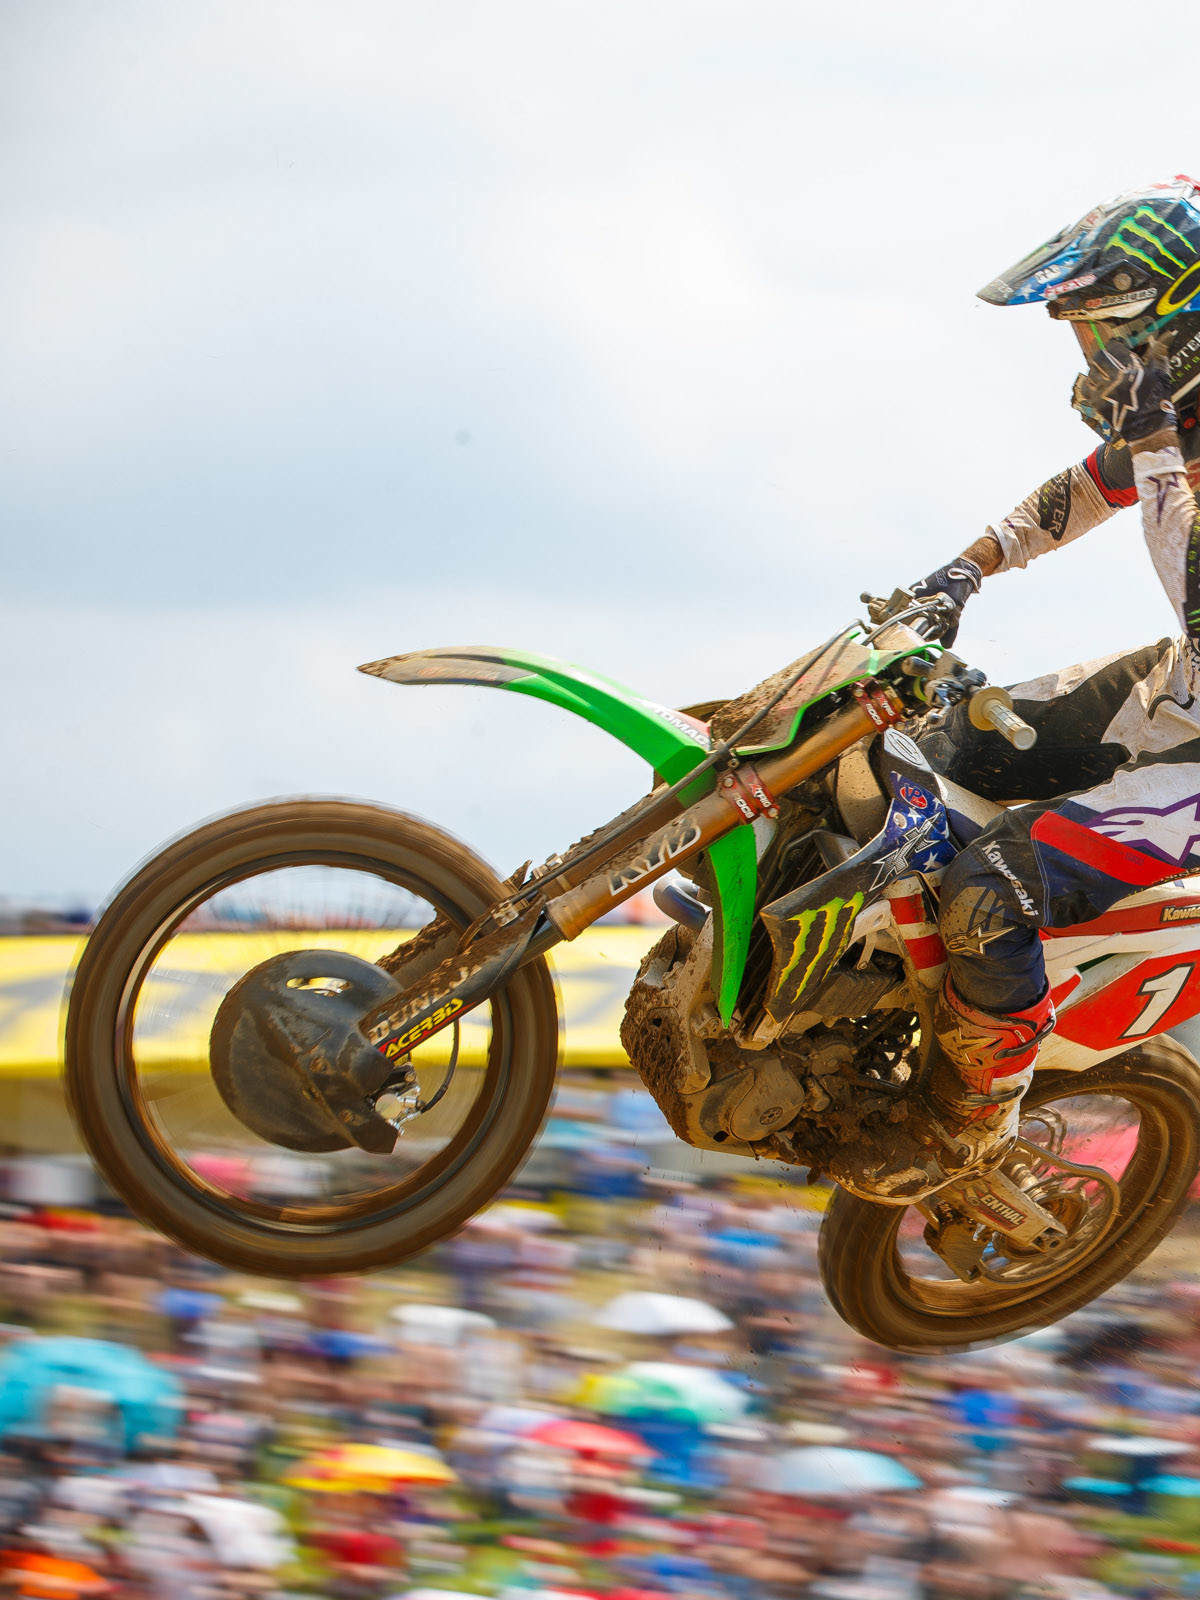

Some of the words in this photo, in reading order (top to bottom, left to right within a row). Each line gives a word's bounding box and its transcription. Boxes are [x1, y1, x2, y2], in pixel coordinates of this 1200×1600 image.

[654, 708, 710, 746] TOMAC
[981, 840, 1039, 917] Kawasaki
[367, 964, 483, 1046] DUNLO
[1116, 961, 1196, 1040] 1
